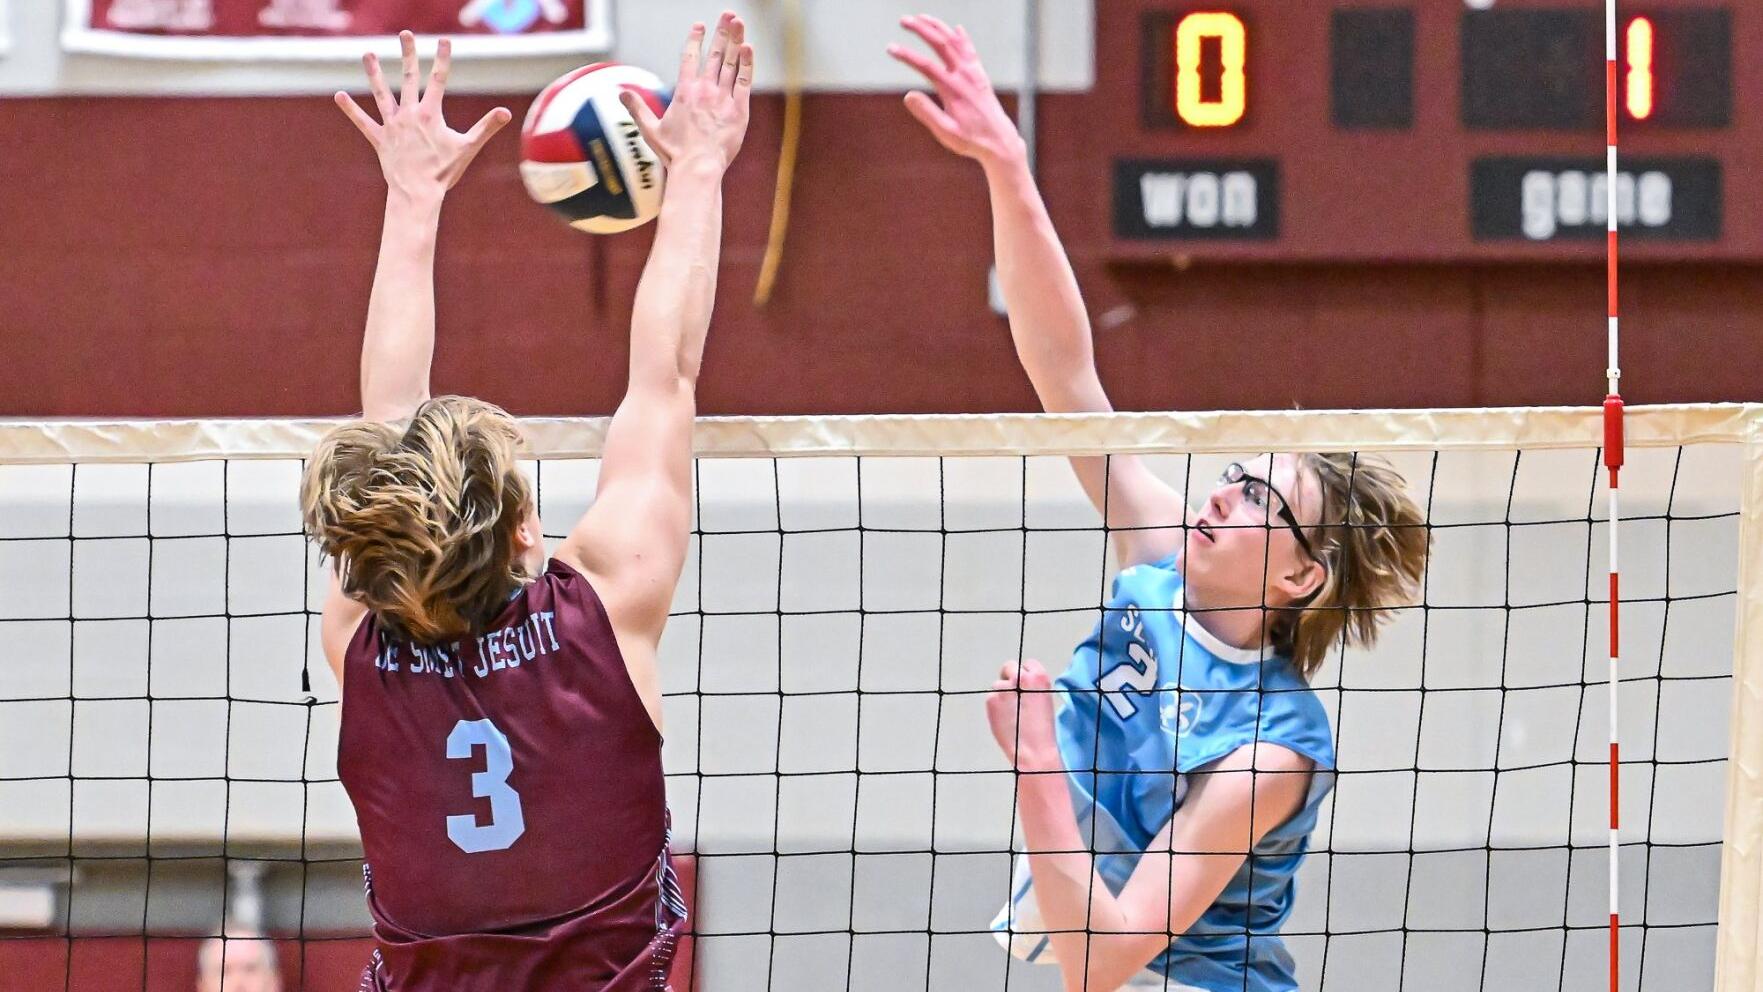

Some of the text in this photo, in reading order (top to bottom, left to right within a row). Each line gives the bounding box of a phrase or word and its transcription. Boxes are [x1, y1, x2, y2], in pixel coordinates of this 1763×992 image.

[1176, 11, 1246, 127] 0
[1626, 16, 1652, 119] 1
[1141, 171, 1257, 227] won
[1522, 170, 1672, 239] game
[474, 611, 560, 678] JESUIT
[1094, 643, 1159, 721] 2
[446, 718, 526, 854] 3
